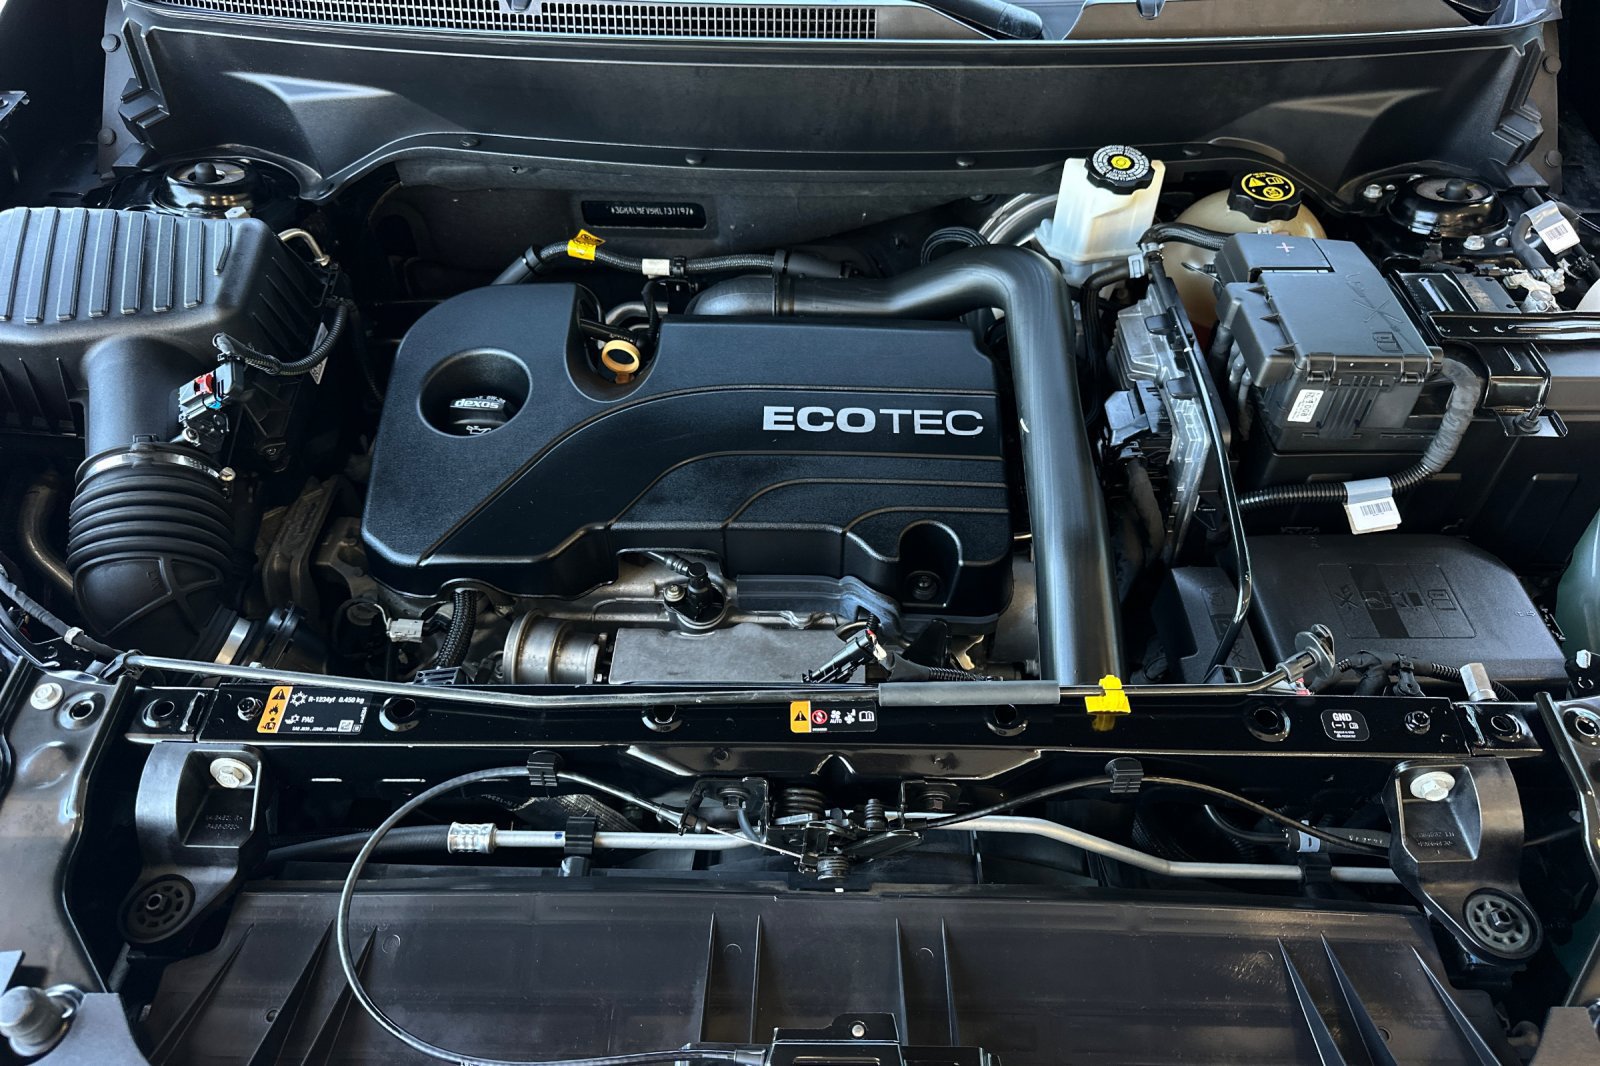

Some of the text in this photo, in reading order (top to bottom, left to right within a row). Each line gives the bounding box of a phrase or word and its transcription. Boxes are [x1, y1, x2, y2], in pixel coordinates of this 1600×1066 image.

[454, 399, 499, 409] dexos
[762, 405, 984, 436] ECOTEC
[308, 696, 336, 704] R-1234yf
[1332, 712, 1352, 721] GND
